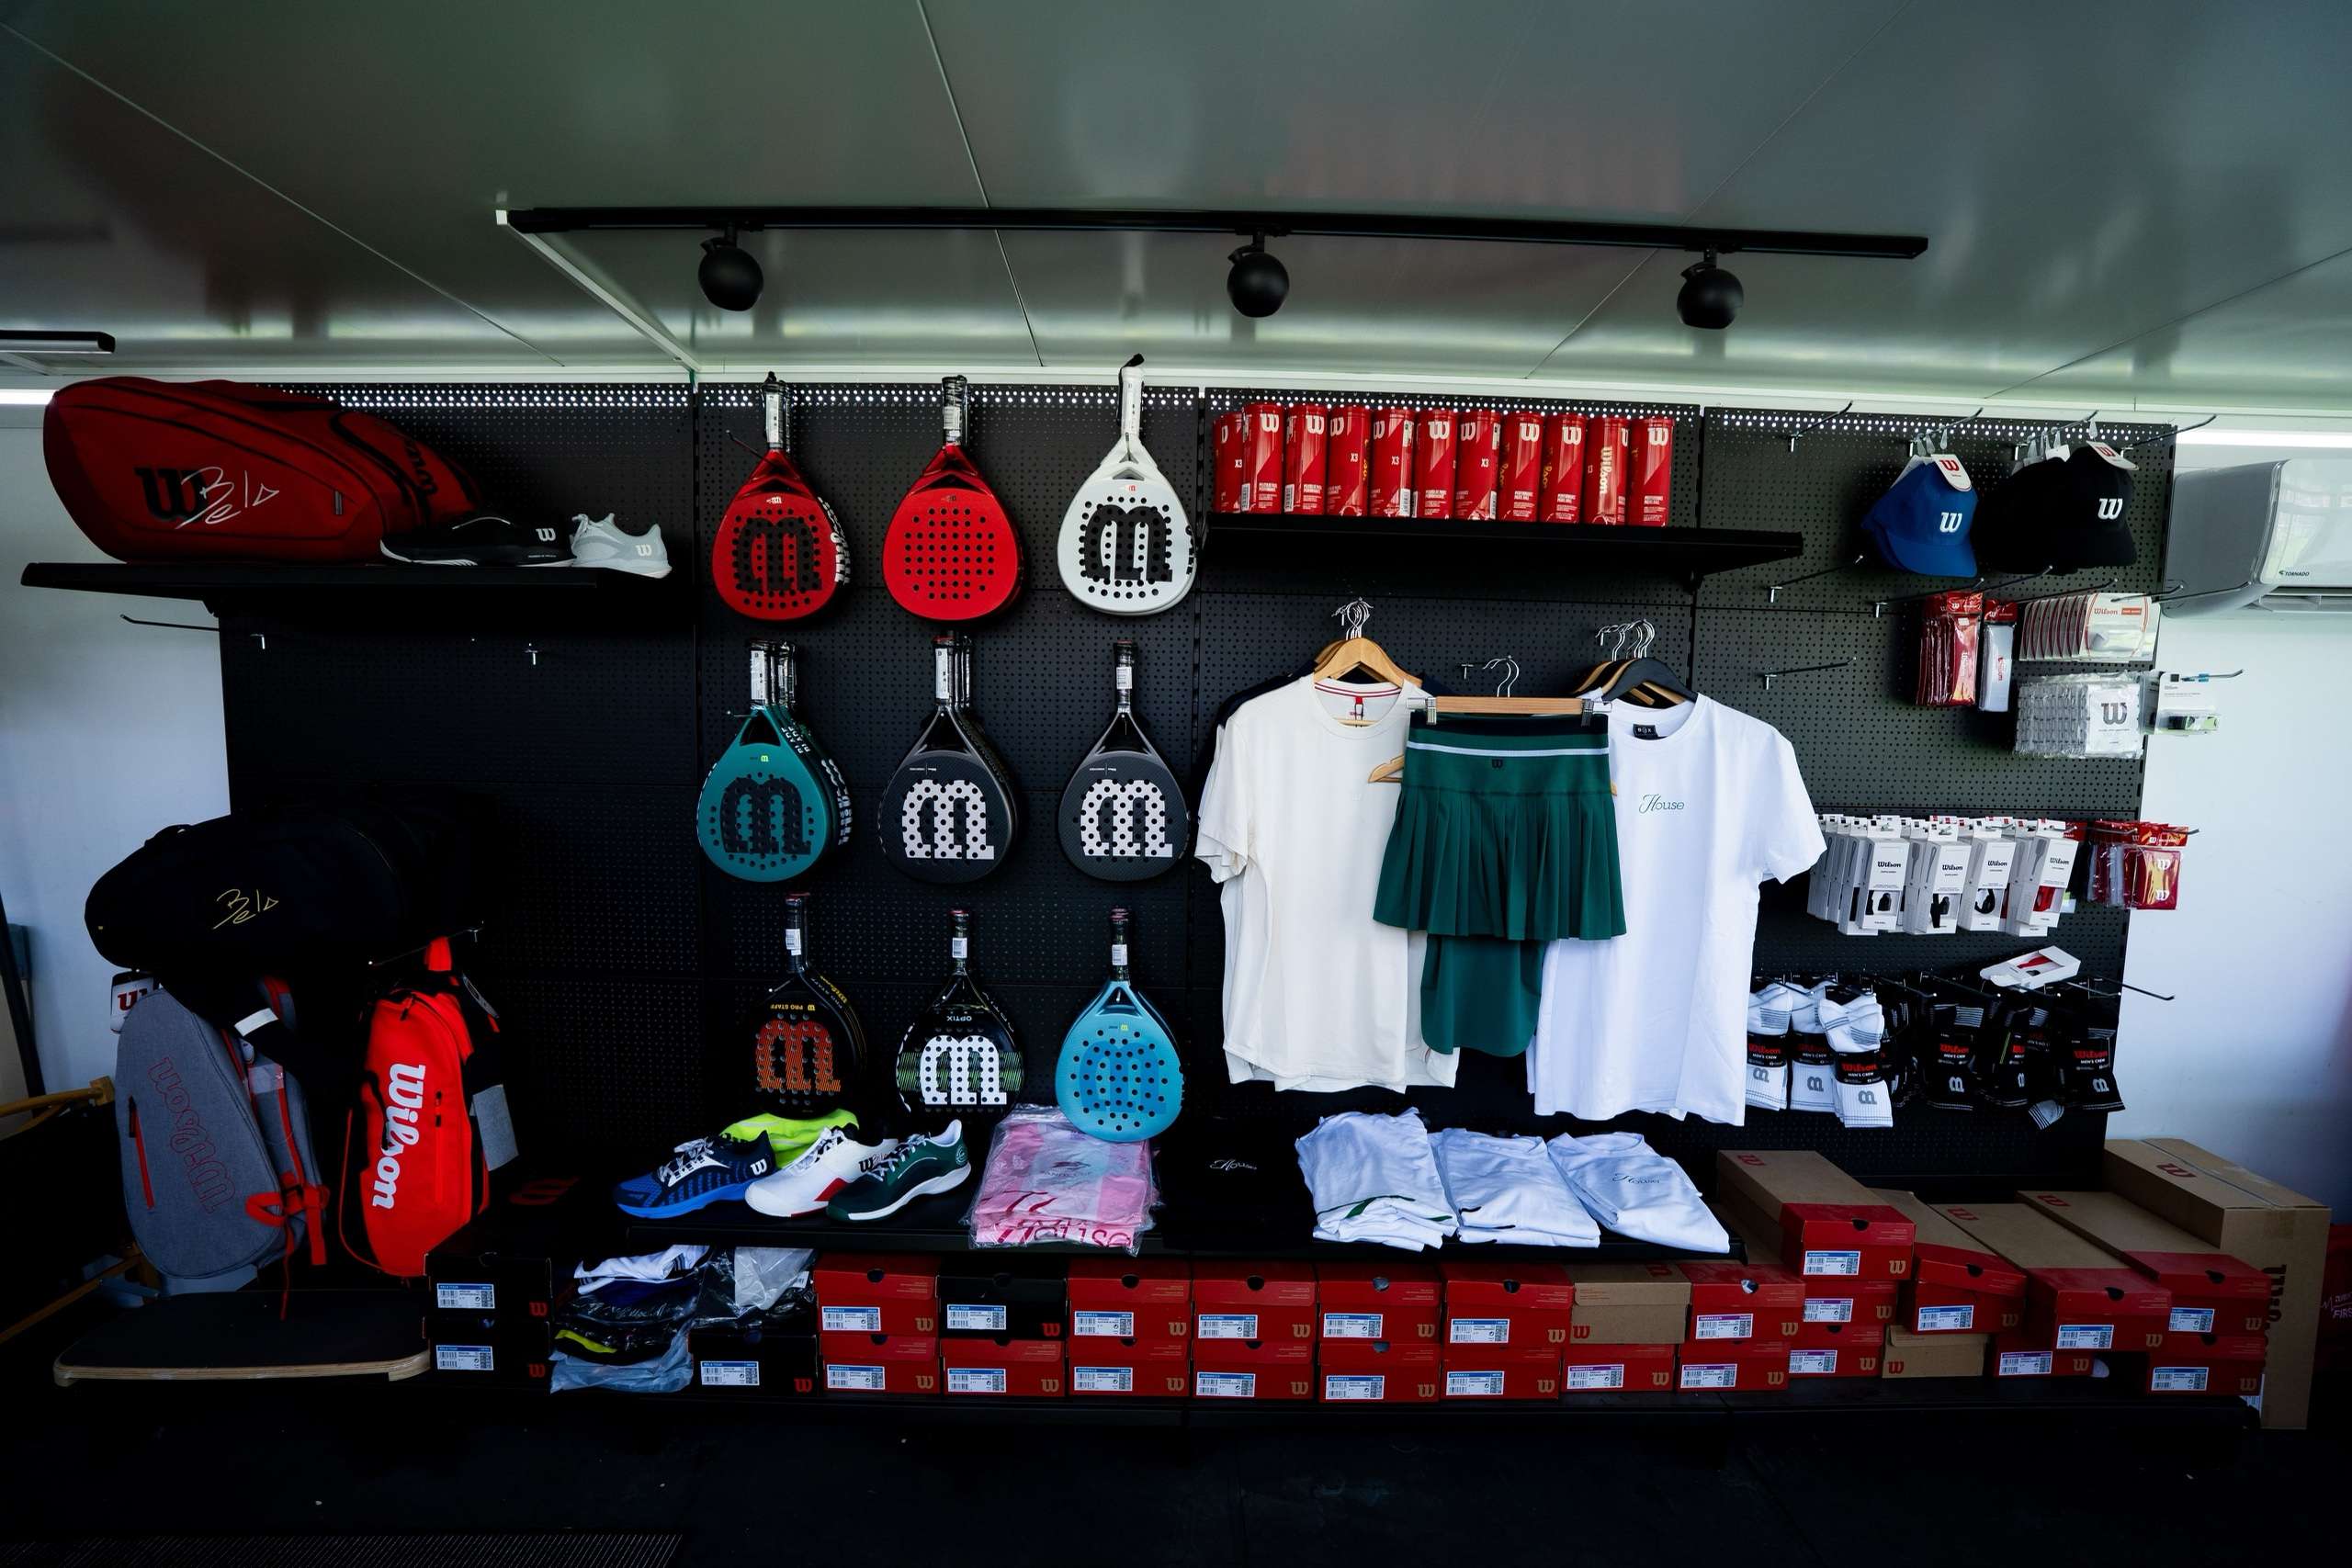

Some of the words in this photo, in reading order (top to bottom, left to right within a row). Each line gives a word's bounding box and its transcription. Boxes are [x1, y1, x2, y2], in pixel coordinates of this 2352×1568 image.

[1260, 413, 1279, 433] W
[1306, 415, 1324, 434] W
[1330, 417, 1344, 436] W
[1428, 421, 1450, 439] W
[1461, 423, 1476, 441] W
[1520, 423, 1540, 442] W
[1562, 426, 1582, 446] W
[1647, 427, 1668, 446] W
[1600, 446, 1612, 493] Wilson
[2098, 498, 2123, 520] W
[1939, 512, 1962, 533] W
[536, 527, 556, 542] W
[635, 545, 652, 558] W
[2101, 703, 2128, 725] W
[1639, 793, 1685, 814] House
[1747, 1043, 1782, 1055] Wilson
[1841, 1061, 1878, 1073] Wilson
[372, 1062, 425, 1210] Wilson
[750, 1158, 767, 1176] W
[1889, 1259, 1906, 1274] W
[1875, 1305, 1893, 1320] W
[915, 1316, 933, 1332] W
[2001, 1314, 2019, 1327] W
[1042, 1322, 1060, 1337] W
[1168, 1321, 1187, 1336] W
[1292, 1324, 1310, 1337] W
[1417, 1324, 1436, 1337] W
[1547, 1328, 1566, 1343] W
[1573, 1325, 1590, 1338] W
[1781, 1323, 1799, 1337] W
[2146, 1333, 2163, 1348] W
[1860, 1357, 1877, 1371] W
[1888, 1361, 1905, 1374] W
[2073, 1359, 2090, 1372] W
[794, 1378, 812, 1392] W
[915, 1375, 933, 1389] W
[1040, 1378, 1059, 1393] W
[1166, 1377, 1185, 1392] W
[1652, 1372, 1669, 1386] W
[1767, 1371, 1785, 1385] W
[1290, 1381, 1309, 1395] W
[1417, 1383, 1436, 1398] W
[1537, 1379, 1555, 1393] W
